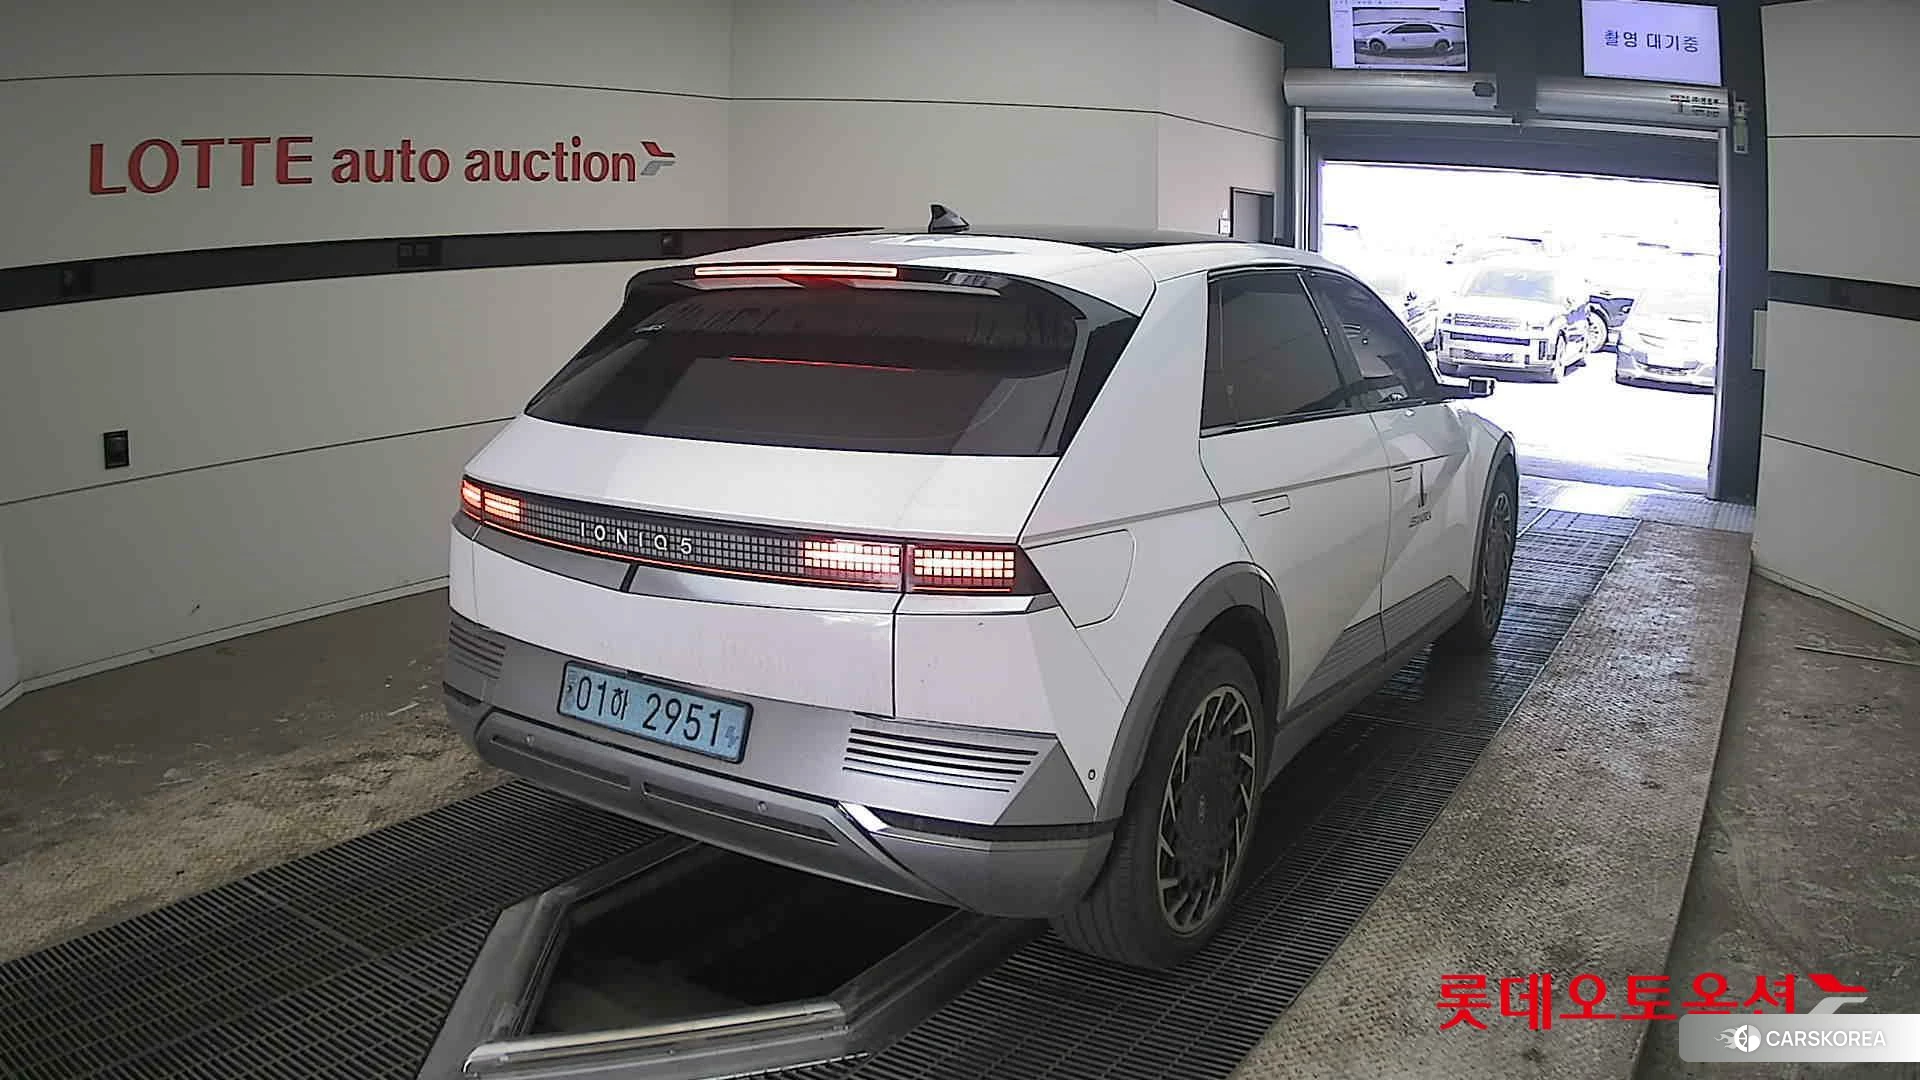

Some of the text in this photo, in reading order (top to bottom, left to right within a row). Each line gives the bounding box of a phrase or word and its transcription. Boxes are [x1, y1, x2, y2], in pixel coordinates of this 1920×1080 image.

[1646, 33, 1699, 52] 대기중
[90, 135, 636, 195] LOTTE auto auction
[576, 676, 721, 746] 01하 2951
